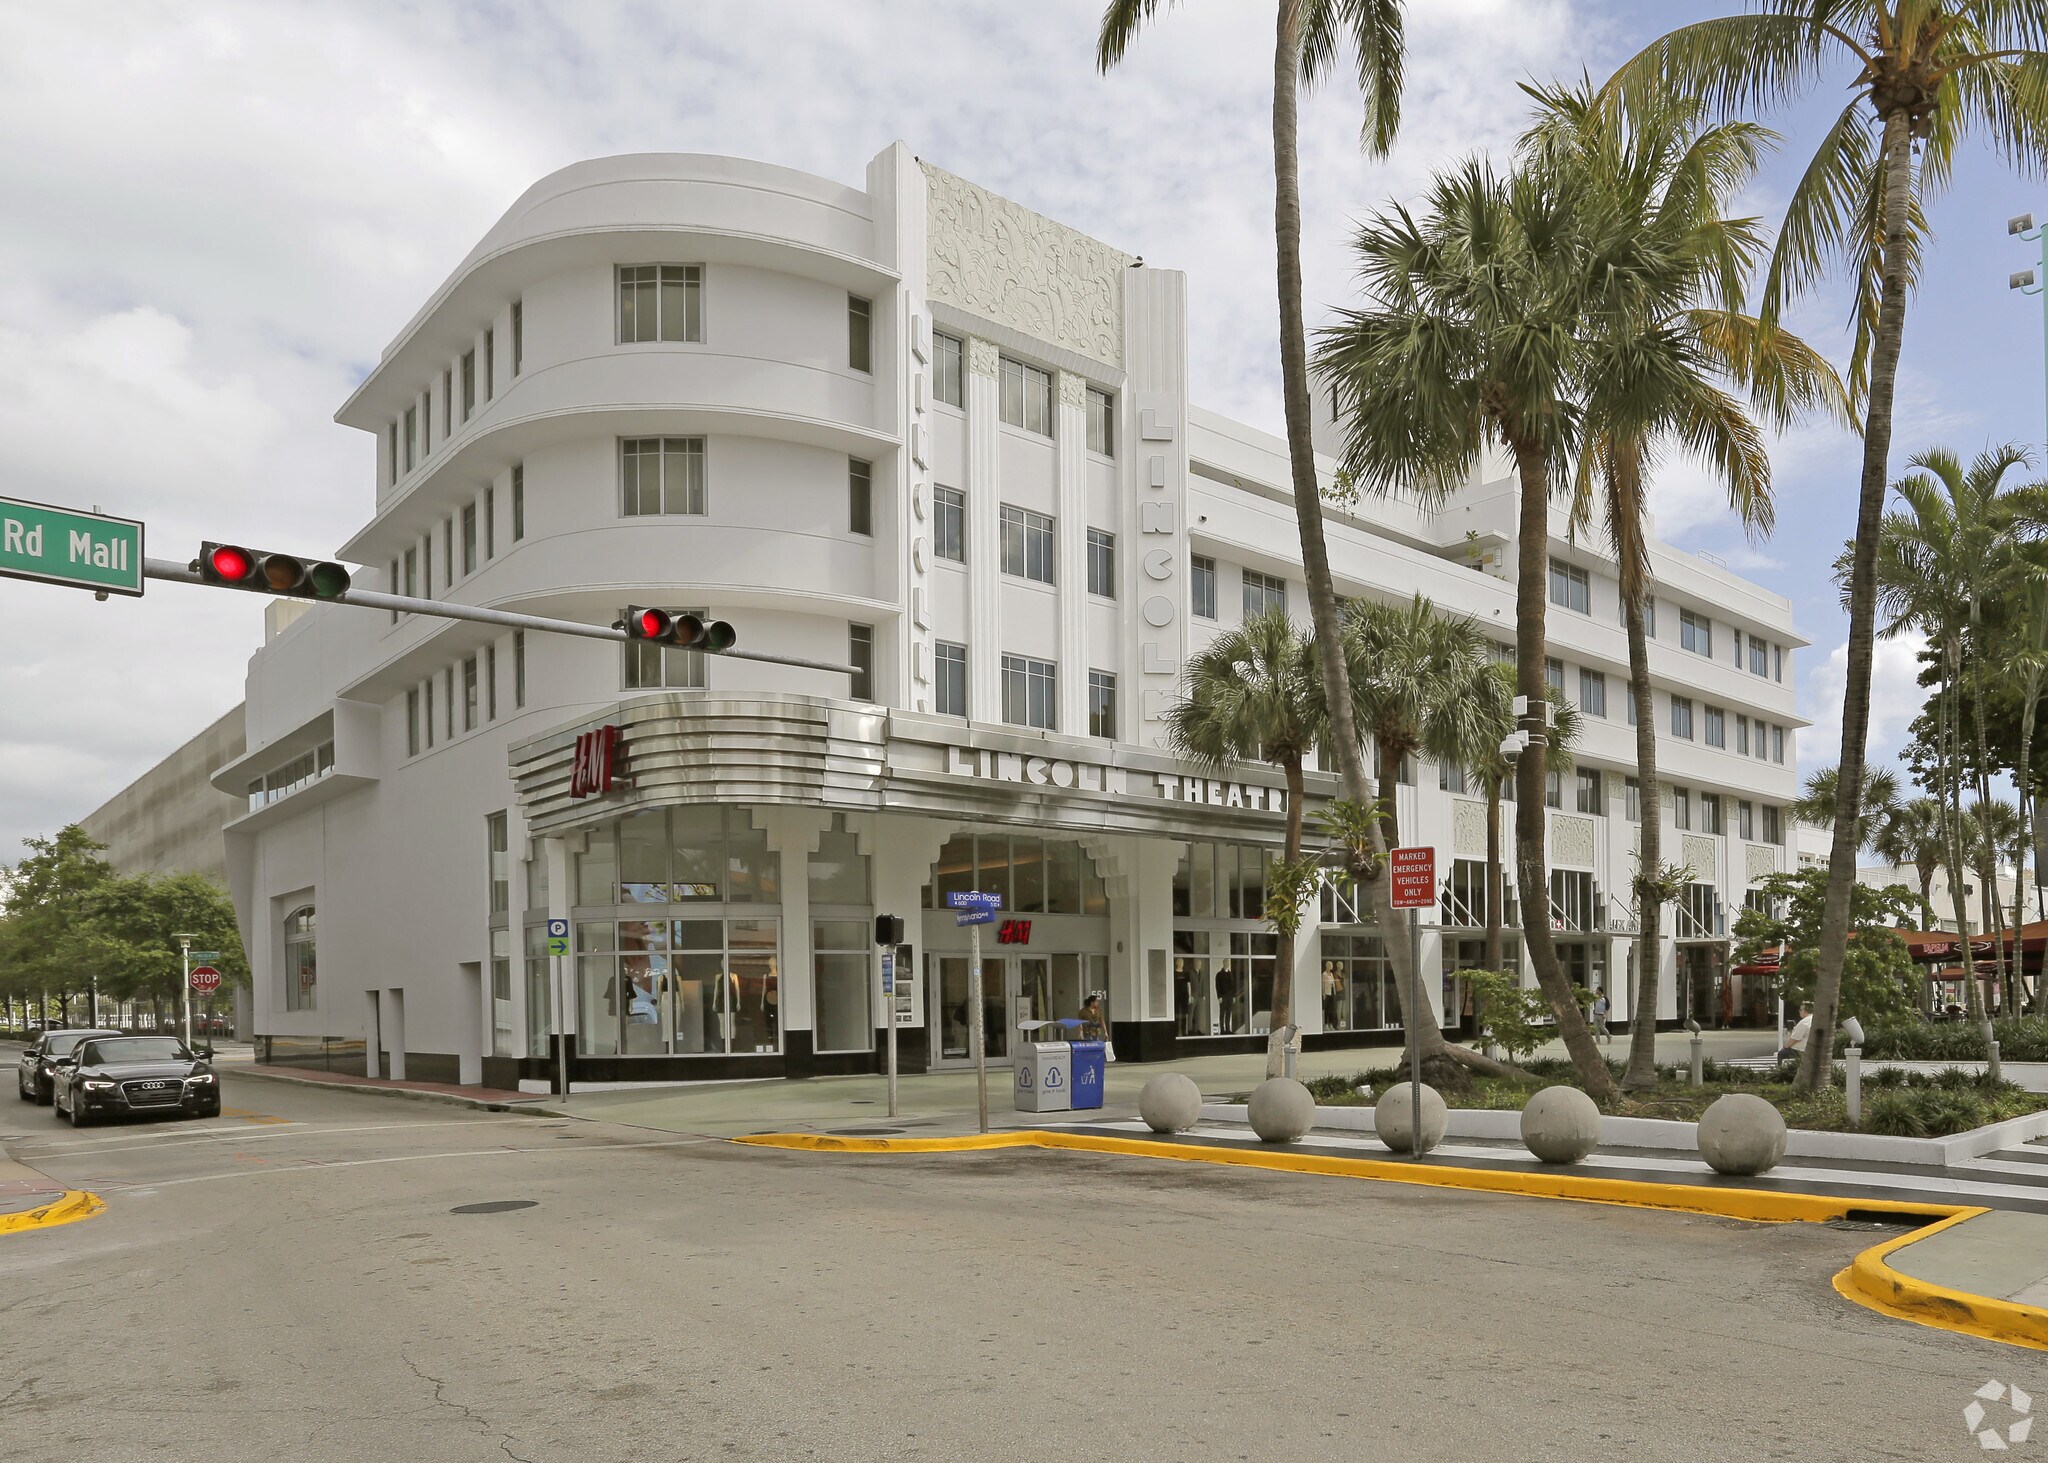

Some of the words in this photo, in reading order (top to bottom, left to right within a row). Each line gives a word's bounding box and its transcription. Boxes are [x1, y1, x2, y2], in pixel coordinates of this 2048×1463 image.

[911, 314, 931, 685] LINCOLN
[4, 518, 43, 557] Rd
[69, 529, 127, 571] Mall
[1141, 408, 1175, 721] LINCOLN
[569, 724, 615, 799] H&M
[949, 745, 1127, 795] LINCOLN
[1158, 773, 1289, 814] THEATR
[1398, 852, 1426, 861] MARKED
[1393, 864, 1432, 874] EMERGENCY
[1397, 876, 1429, 885] VEHICLES
[953, 892, 981, 902] Lincoln
[982, 893, 1000, 903] Road
[1404, 888, 1421, 897] ONLY
[192, 974, 219, 984] STOP
[1091, 989, 1107, 1000] 551
